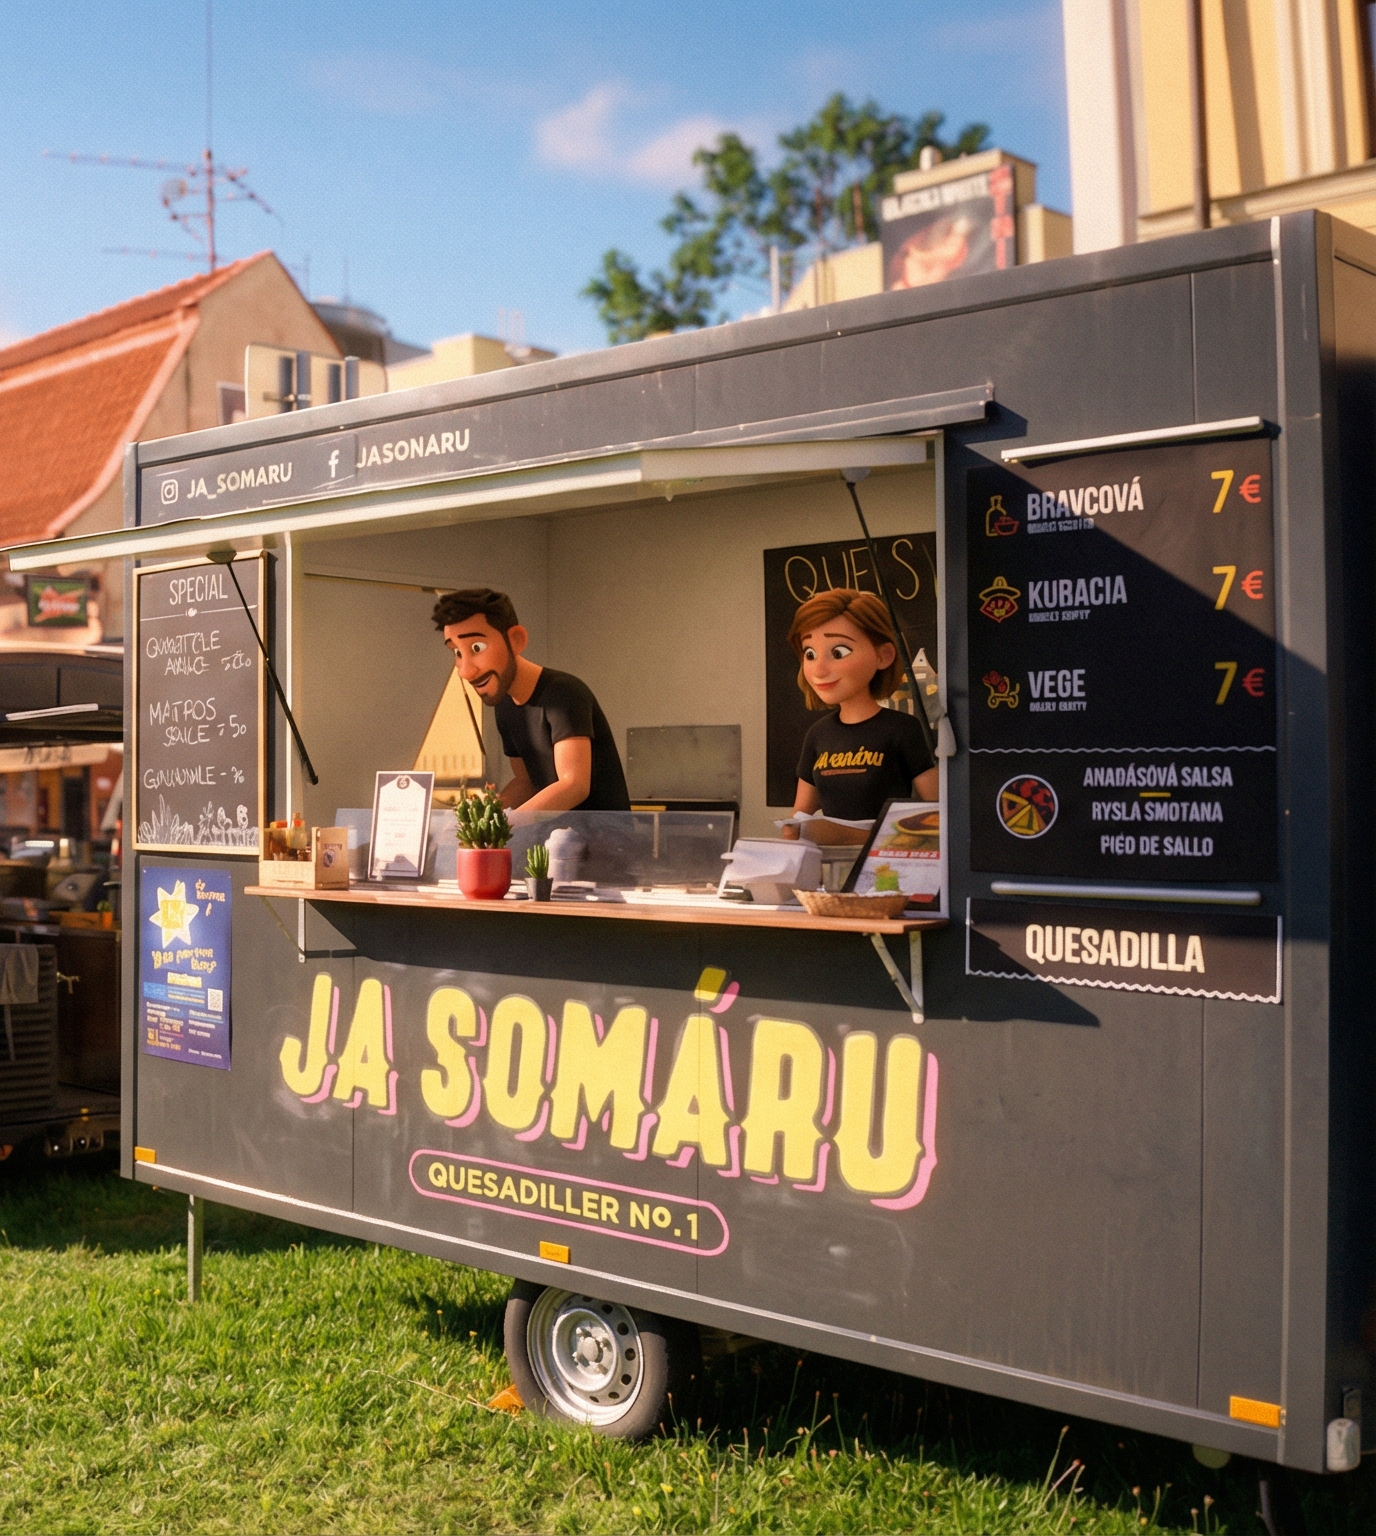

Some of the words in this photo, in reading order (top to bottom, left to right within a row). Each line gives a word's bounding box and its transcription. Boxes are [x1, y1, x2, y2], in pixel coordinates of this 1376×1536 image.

[356, 428, 471, 468] JASONARU
[1027, 476, 1145, 521] BRAVCOVÁ
[169, 573, 228, 605] SPECIAL
[1028, 575, 1128, 609] KUBACIA
[1028, 669, 1086, 699] VEGE
[1181, 766, 1234, 787] SALSA
[1144, 801, 1224, 823] SMOTANA
[1139, 835, 1160, 856] DE
[1163, 836, 1214, 857] SALLO
[1025, 924, 1206, 974] QUESADILLA
[279, 973, 398, 1115] JA
[420, 966, 937, 1211] SOMÁRU
[428, 1161, 620, 1224] QUESADILLER
